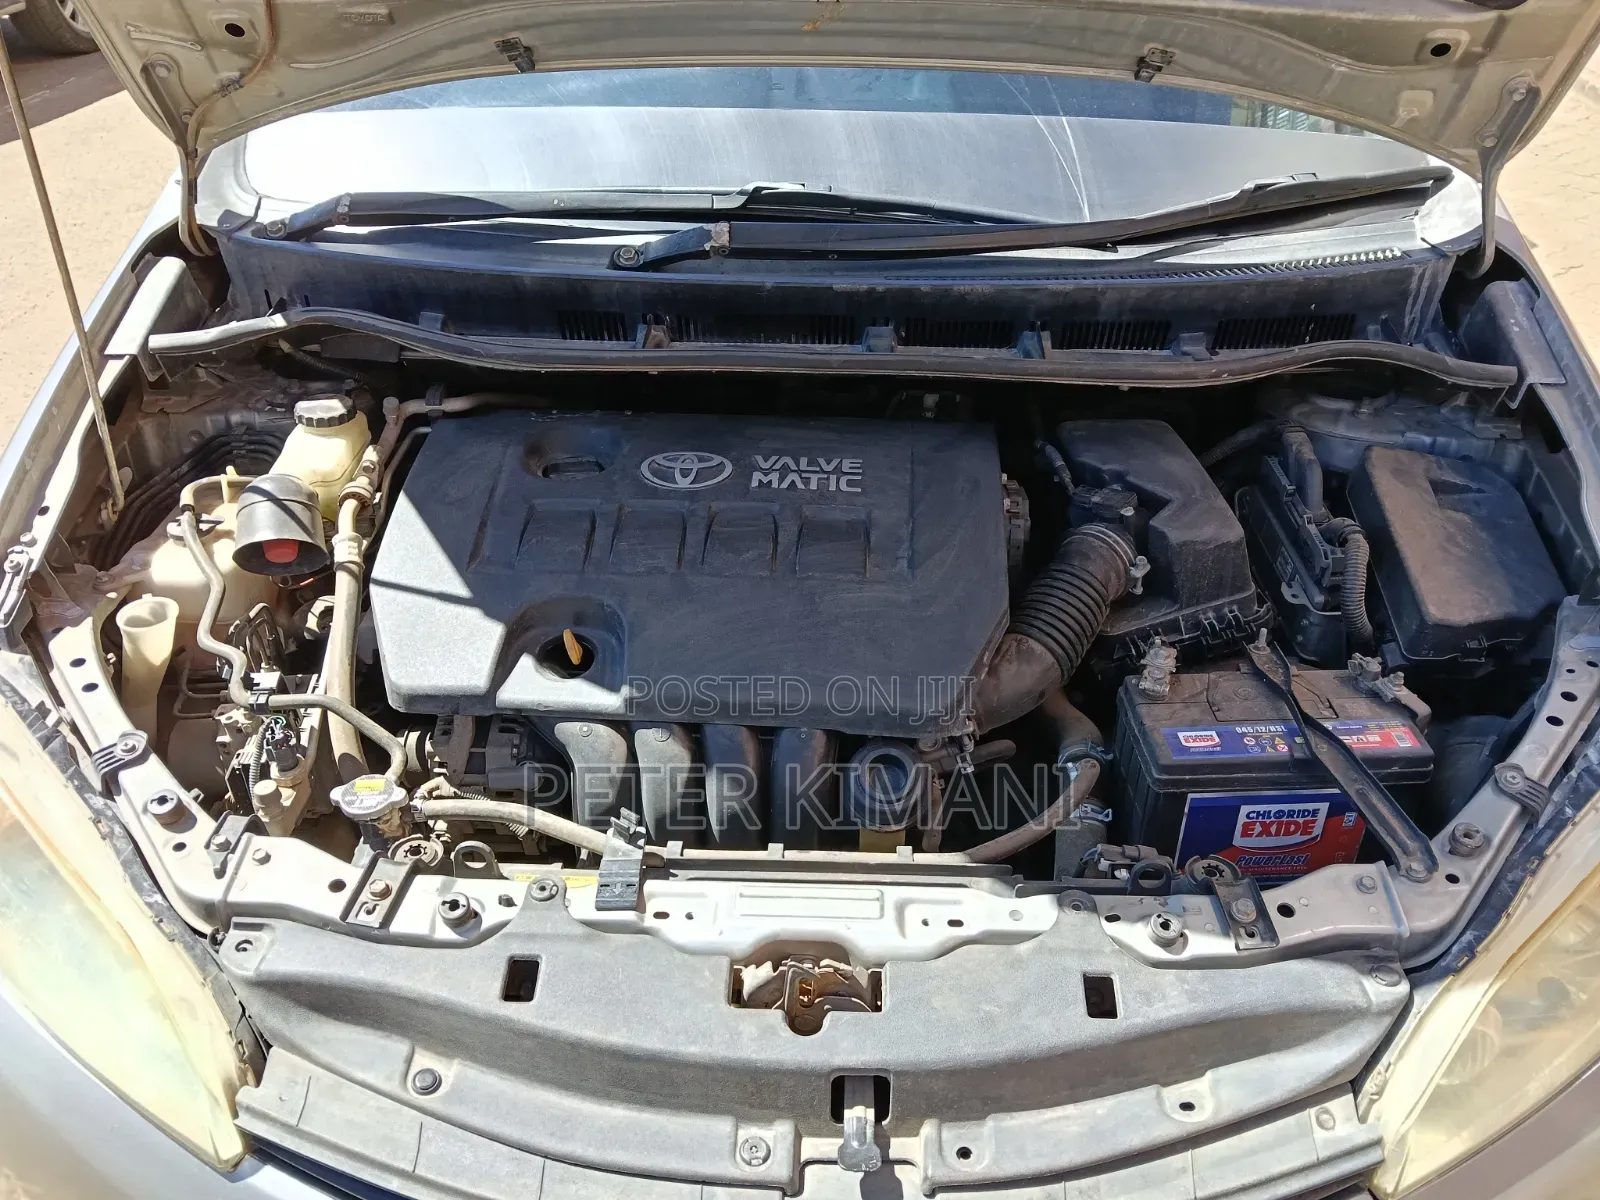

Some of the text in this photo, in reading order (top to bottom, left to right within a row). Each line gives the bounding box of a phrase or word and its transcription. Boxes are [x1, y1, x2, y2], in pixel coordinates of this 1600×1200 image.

[753, 455, 862, 473] VALVE
[751, 471, 862, 492] MATIC
[1246, 808, 1321, 820] CHLORIDE
[1240, 819, 1319, 838] EXIDE
